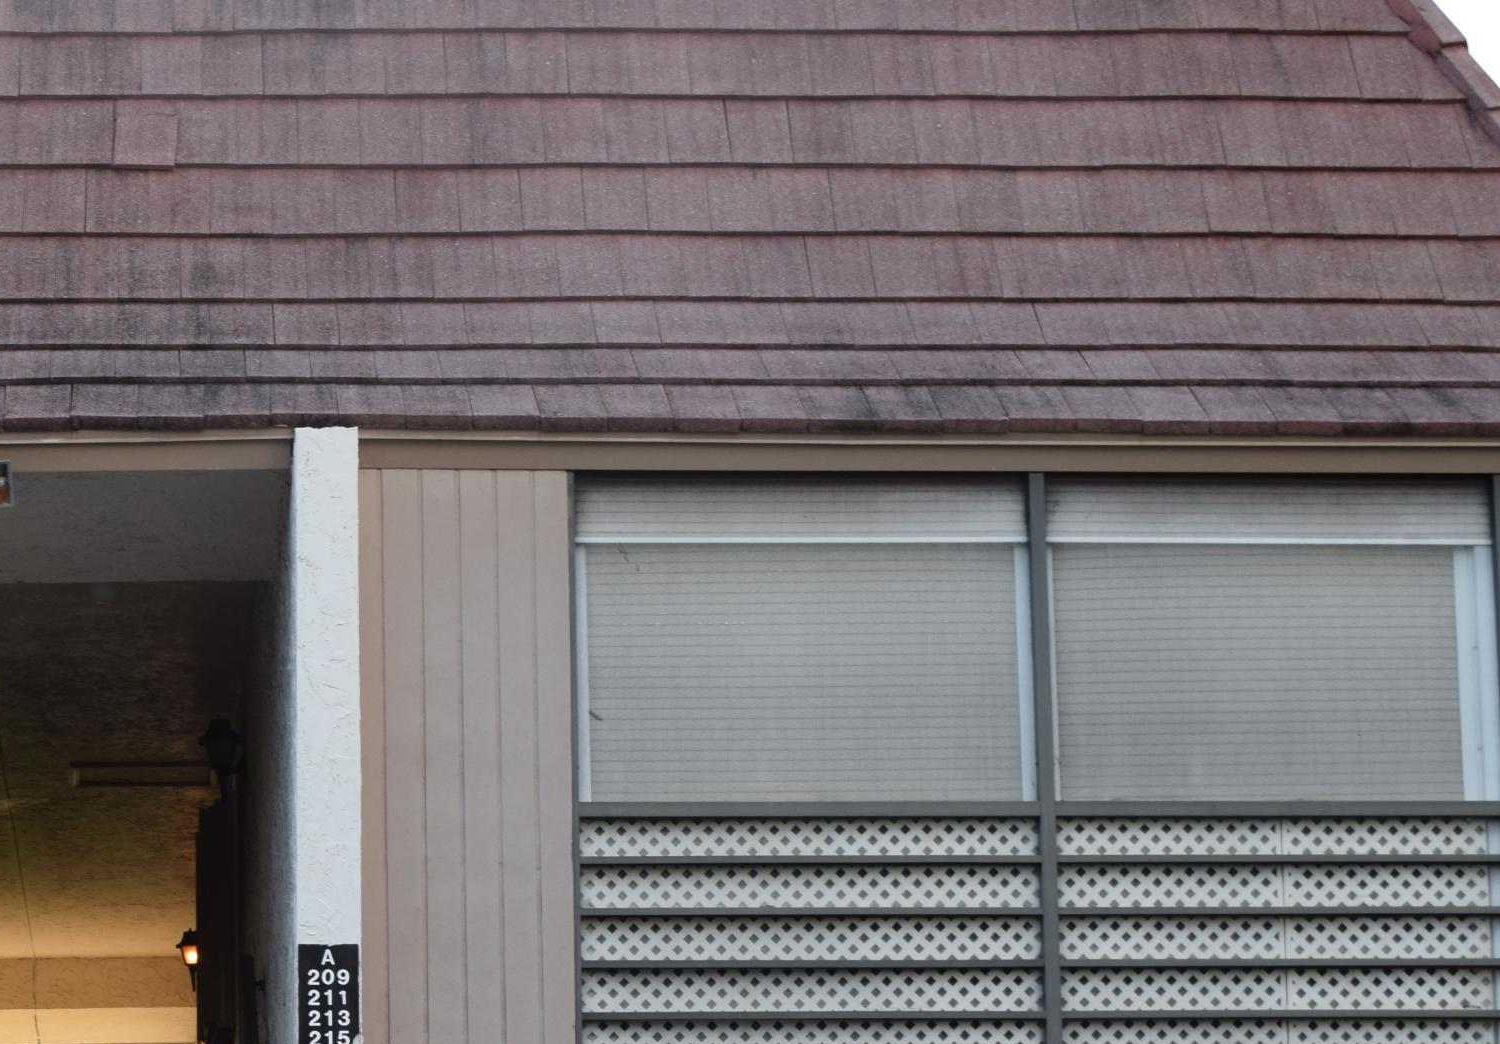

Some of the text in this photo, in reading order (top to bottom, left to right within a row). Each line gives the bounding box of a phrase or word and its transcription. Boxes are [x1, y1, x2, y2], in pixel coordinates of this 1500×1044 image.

[321, 949, 335, 965] A
[307, 969, 350, 986] 209
[308, 989, 347, 1006] 211
[308, 1010, 350, 1027] 213
